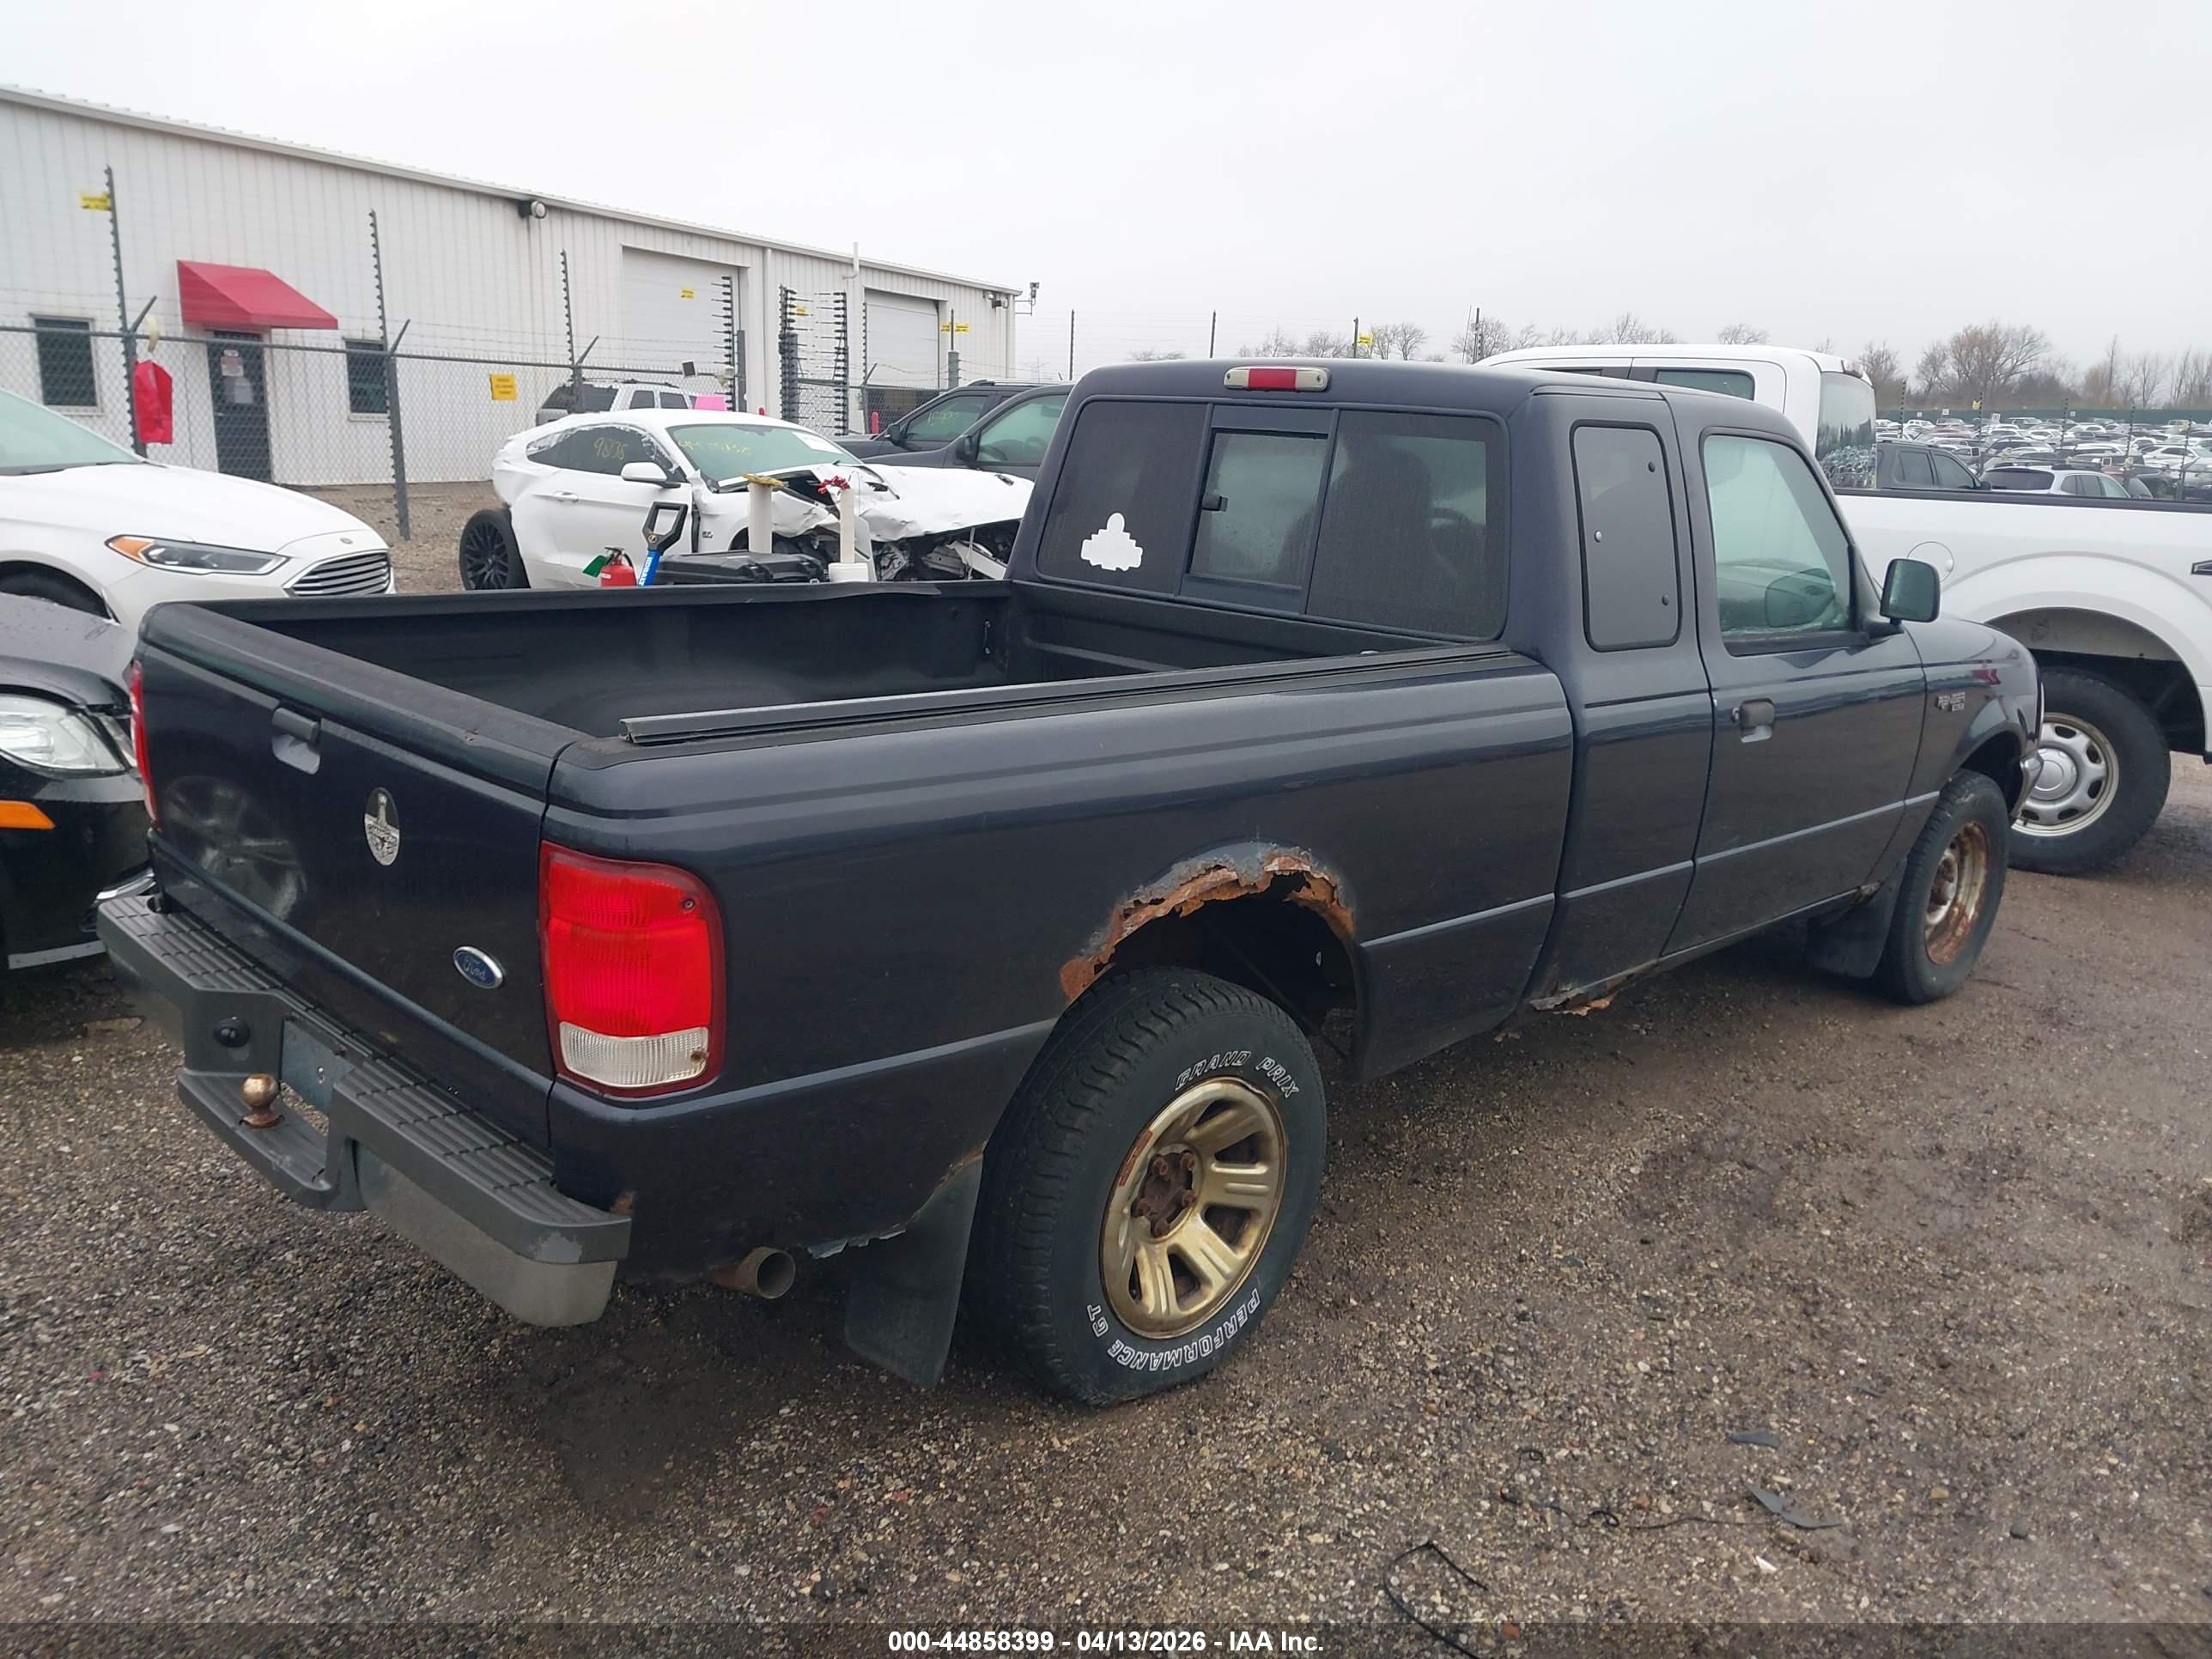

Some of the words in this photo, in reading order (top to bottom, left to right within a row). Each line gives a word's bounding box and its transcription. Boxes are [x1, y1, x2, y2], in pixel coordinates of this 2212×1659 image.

[1175, 1050, 1252, 1091] GRAND
[1255, 1056, 1301, 1099] PRIX
[1086, 1304, 1109, 1338] GT
[1107, 1288, 1261, 1371] PERFORMANCE
